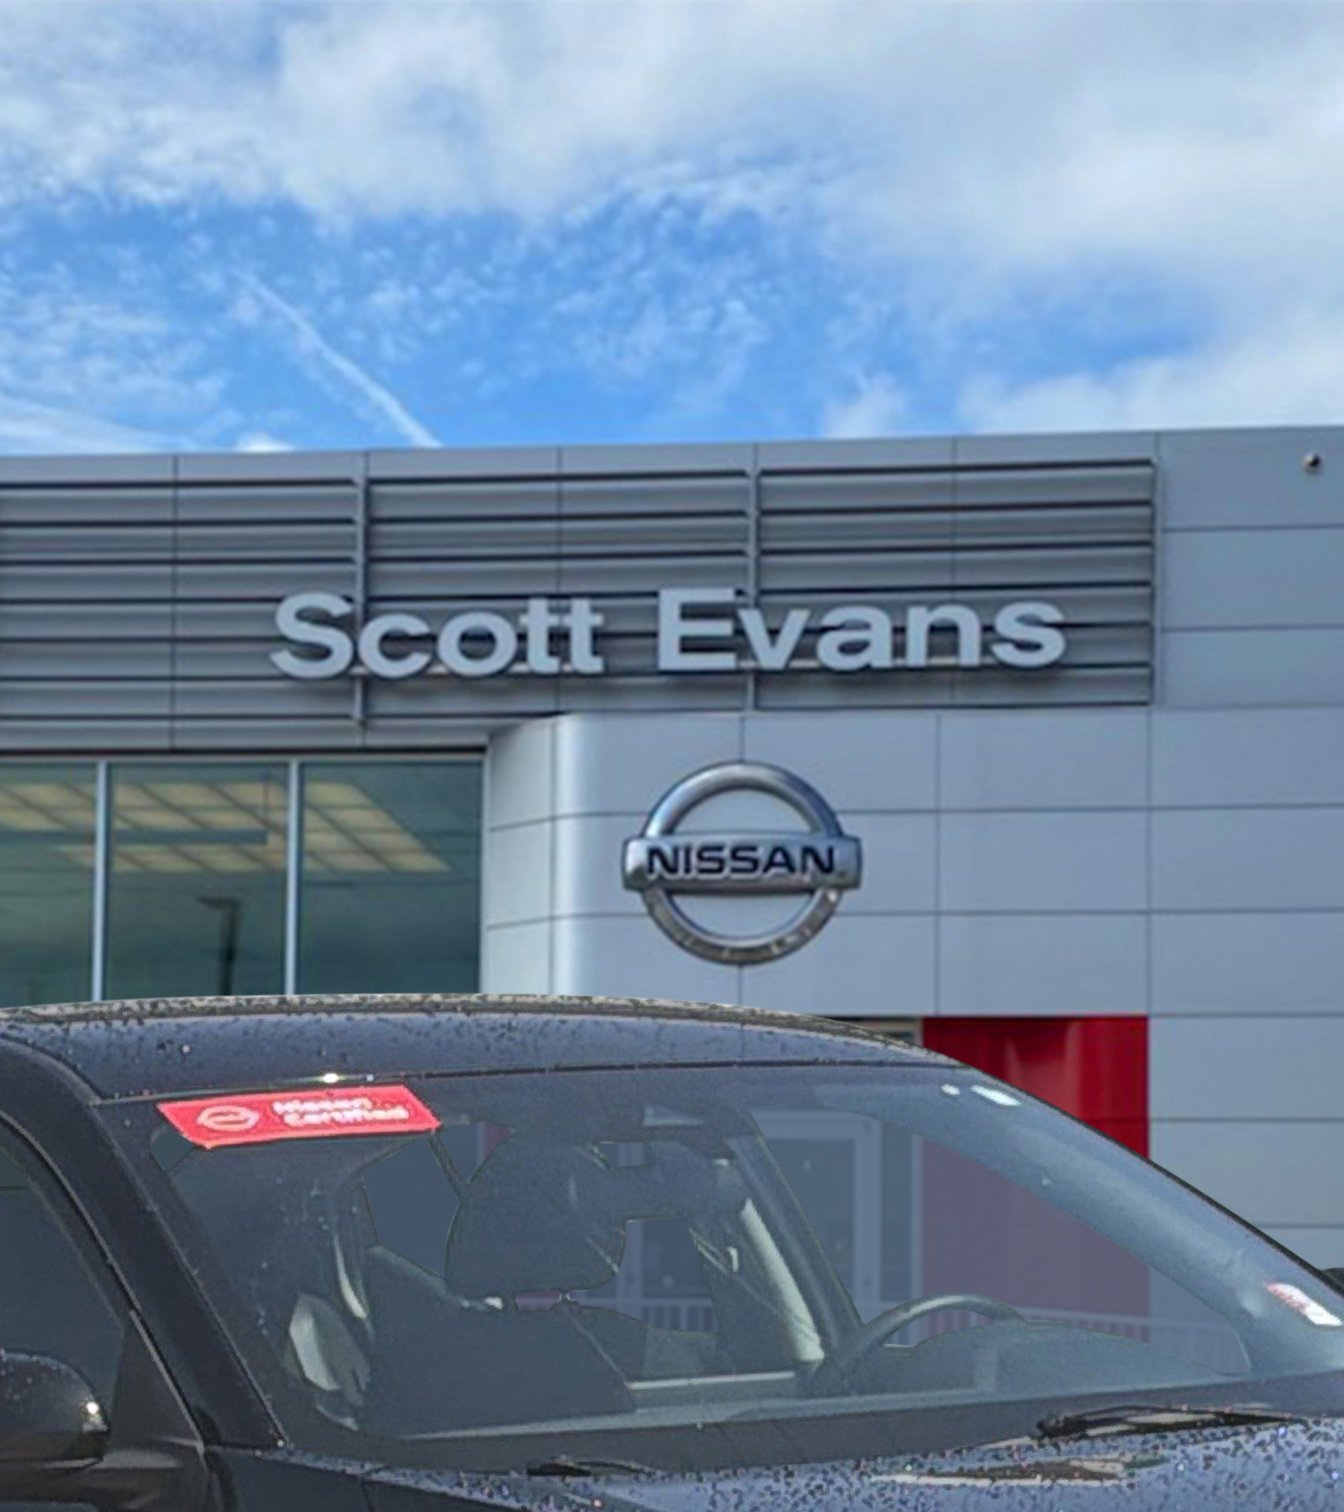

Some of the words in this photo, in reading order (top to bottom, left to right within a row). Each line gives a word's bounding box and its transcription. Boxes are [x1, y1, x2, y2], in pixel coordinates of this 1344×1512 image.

[269, 591, 605, 679] Scott
[656, 588, 1067, 672] Evans
[645, 844, 837, 878] NISSAN
